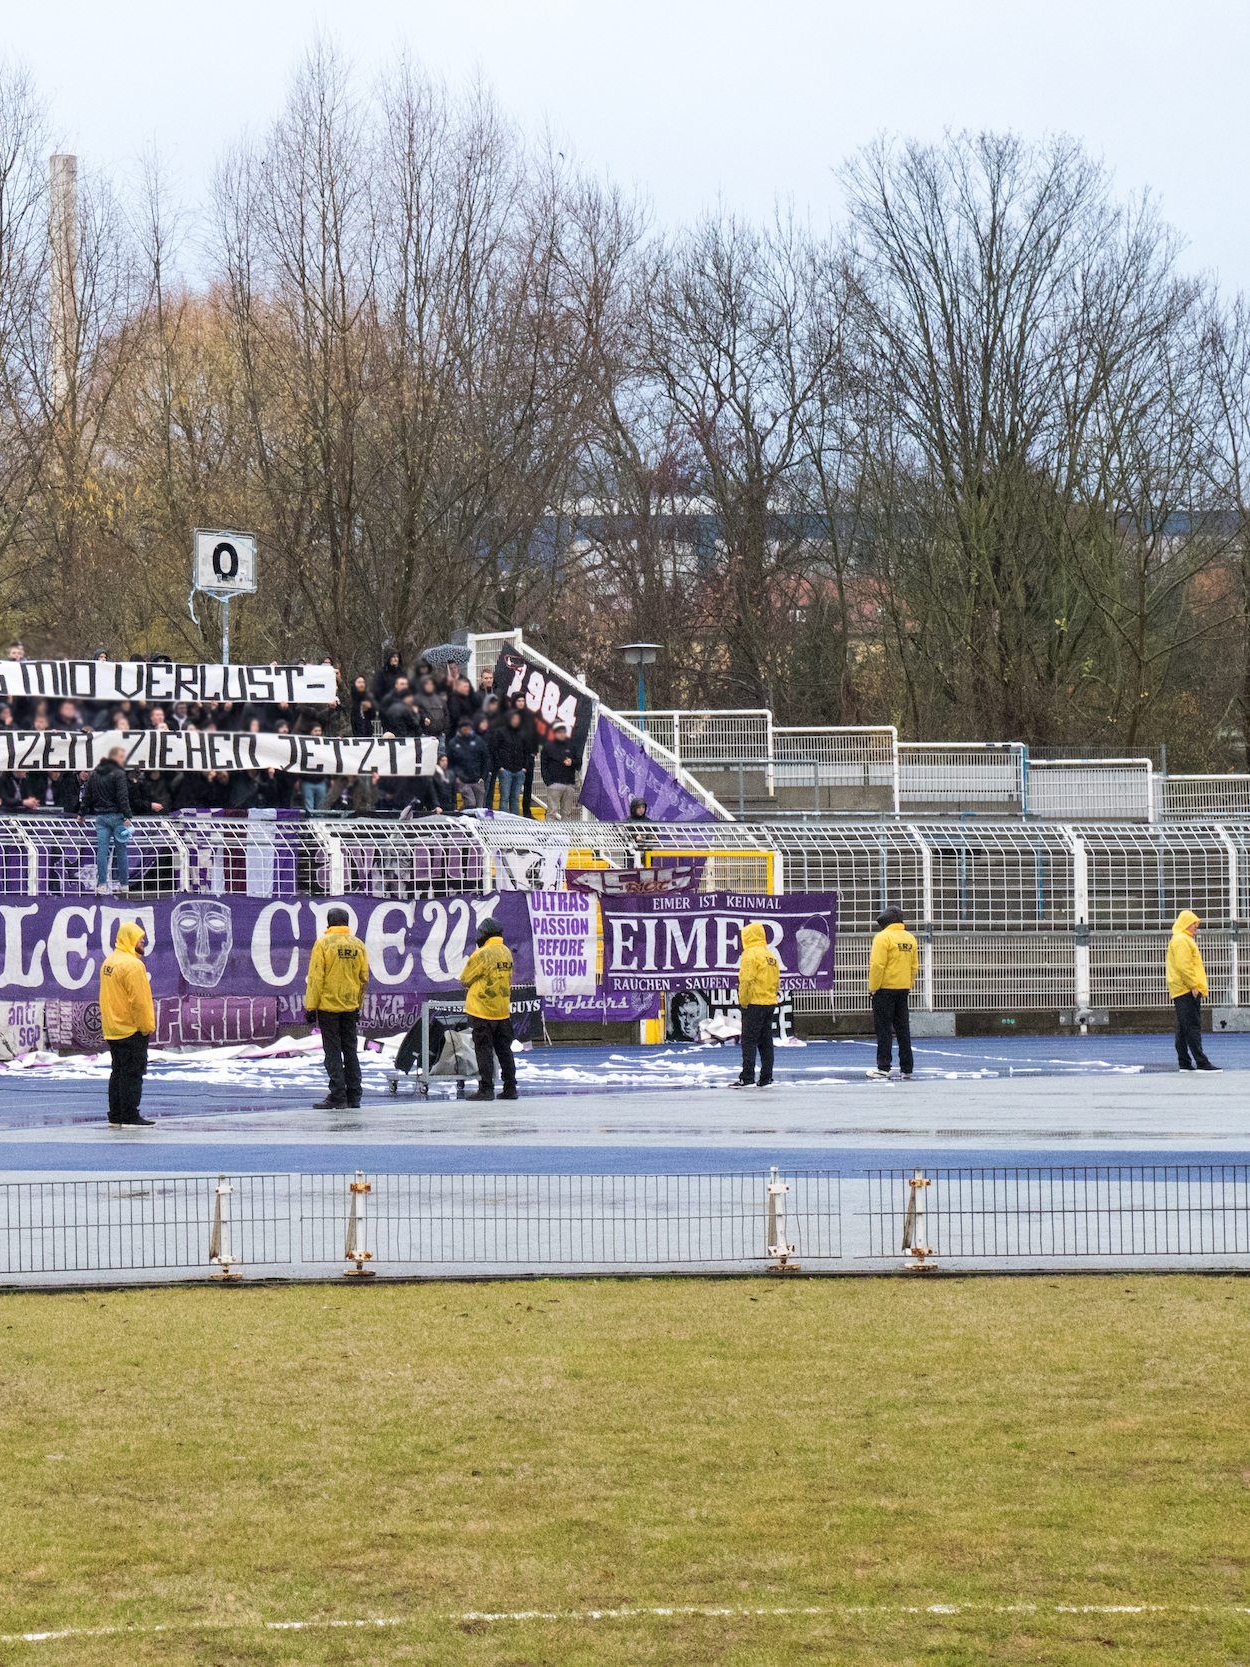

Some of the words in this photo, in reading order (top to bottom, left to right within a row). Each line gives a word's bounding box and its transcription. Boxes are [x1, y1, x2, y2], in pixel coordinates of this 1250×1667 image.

[20, 660, 97, 697] MIO
[505, 655, 578, 738] 1984
[122, 731, 259, 771] ZIEHEN
[278, 734, 423, 776] JETZT!
[530, 891, 589, 912] ULTRAS
[653, 897, 691, 910] EIMER
[699, 895, 718, 907] IST
[726, 896, 781, 910] KEINMAL
[533, 917, 589, 935] PASSION
[538, 939, 585, 957] BEFORE
[613, 978, 671, 991] RAUCHEN
[686, 977, 730, 990] SAUFEN
[510, 998, 541, 1014] GUYS
